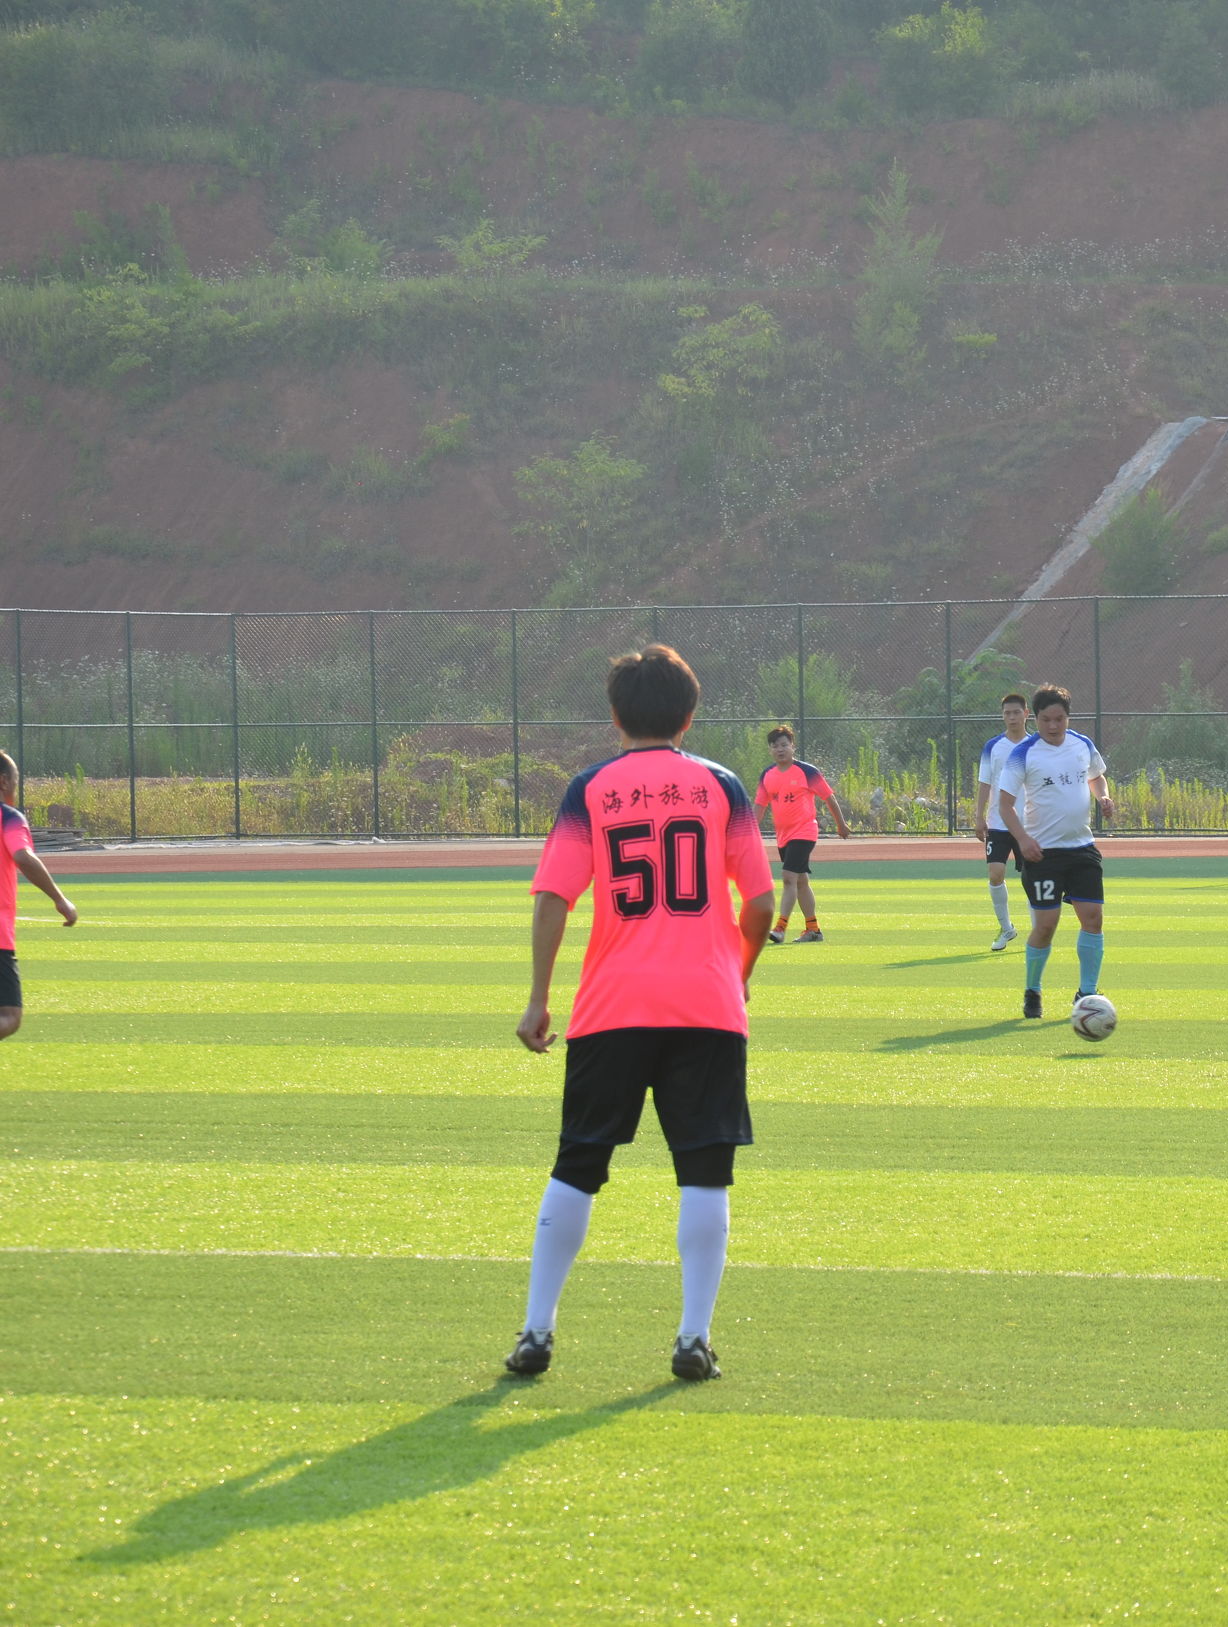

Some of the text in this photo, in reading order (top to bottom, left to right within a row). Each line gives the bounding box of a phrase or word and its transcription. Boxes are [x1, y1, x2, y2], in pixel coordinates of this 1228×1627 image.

[602, 783, 709, 814] 海外旅游
[603, 816, 711, 921] 50
[1033, 879, 1056, 901] 12
